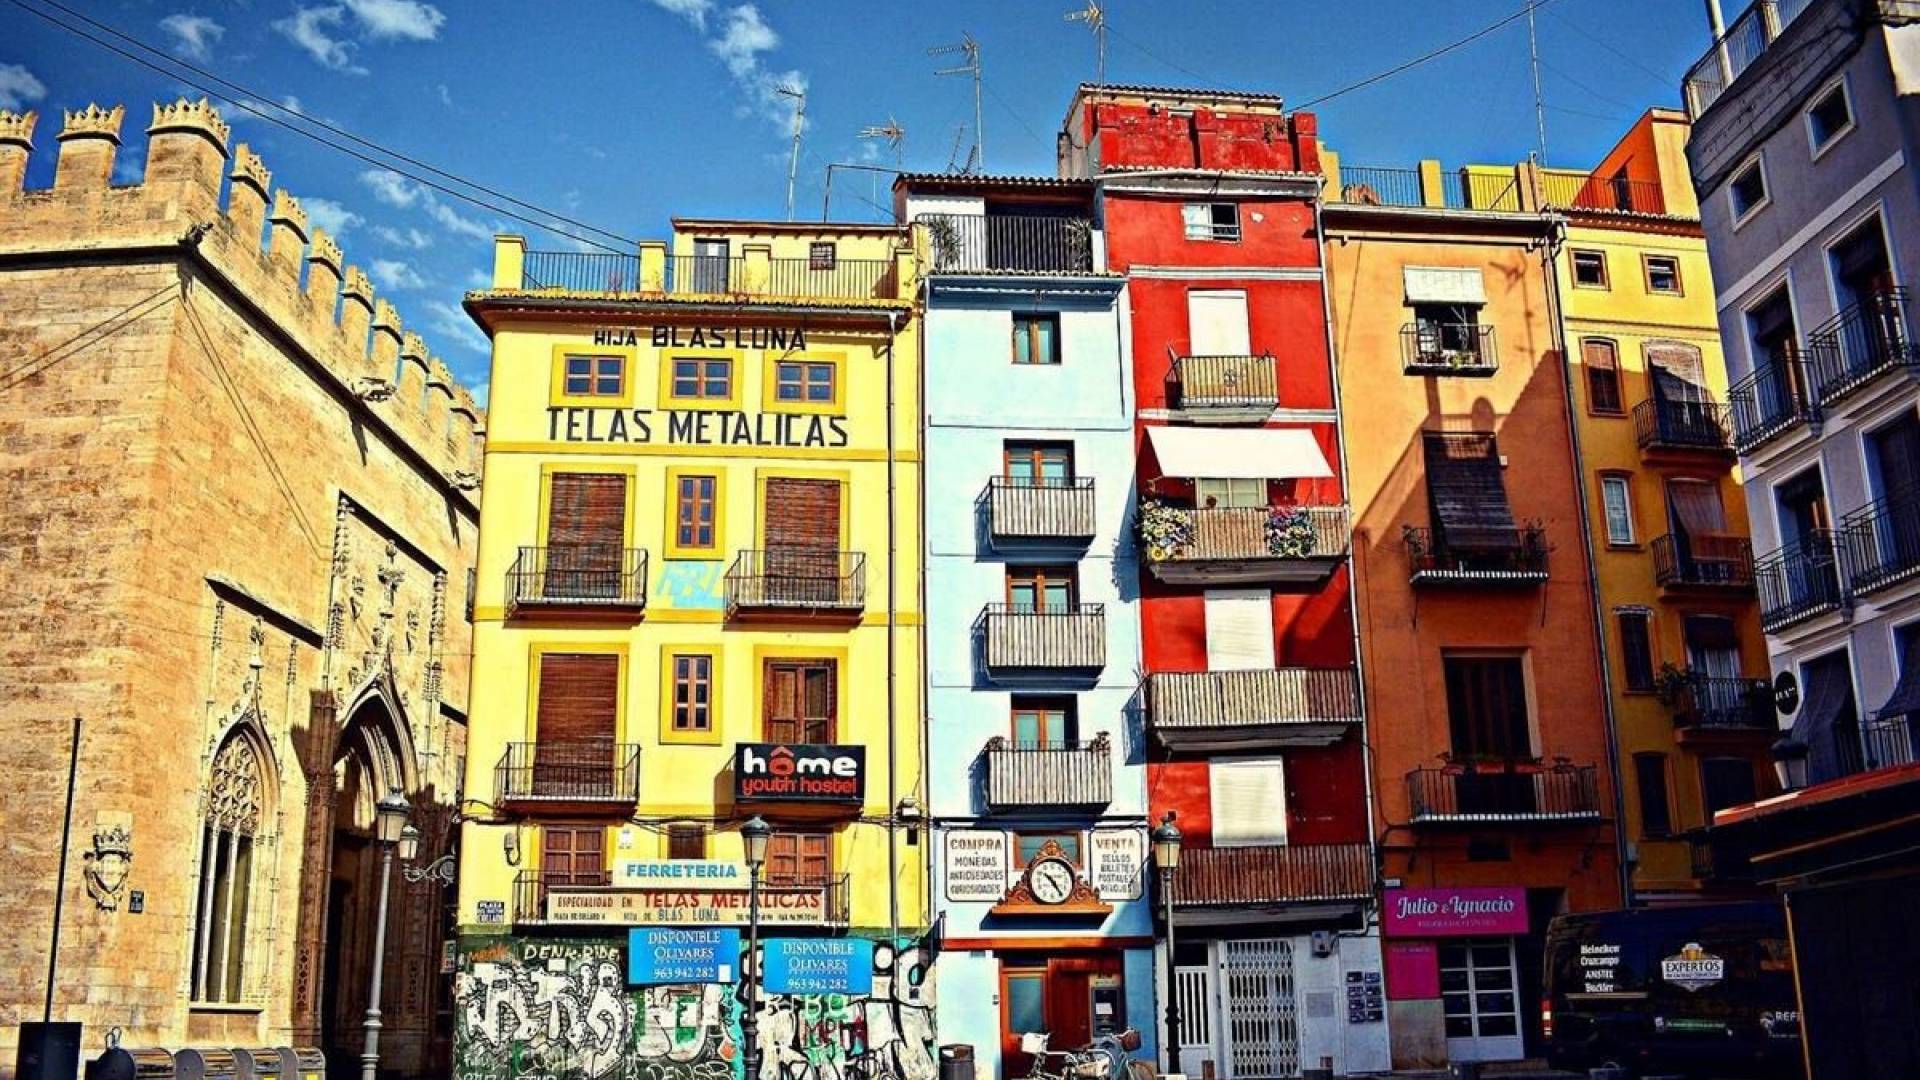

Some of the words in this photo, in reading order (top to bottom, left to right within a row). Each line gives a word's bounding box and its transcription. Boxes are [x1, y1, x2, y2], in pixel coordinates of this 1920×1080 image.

[594, 330, 637, 346] HIJA
[652, 325, 726, 348] BLAS
[735, 327, 806, 350] LUNA
[546, 407, 651, 443] TELAS
[668, 411, 847, 447] METALICAS
[742, 777, 795, 796] youth
[801, 778, 857, 794] hostel
[950, 838, 1002, 850] COMPRA
[1096, 838, 1135, 849] VENTA
[955, 856, 997, 867] MONEDAS
[626, 863, 738, 878] FERRETERIA
[557, 896, 614, 908] ESPECIALIDAD
[643, 892, 700, 909] TELAS
[1396, 896, 1438, 919] Julio
[1449, 895, 1515, 919] Ignacio
[657, 908, 684, 921] BLAS
[648, 930, 721, 944] DISPONIBLE
[654, 946, 714, 959] OLIVARES
[783, 942, 855, 955] DISPONIBLE
[788, 956, 848, 969] OLIVARES
[1666, 962, 1721, 972] EXPERTOS
[654, 968, 673, 979] 963
[674, 967, 694, 978] 942
[696, 967, 715, 978] 282
[788, 979, 806, 990] 963
[830, 979, 849, 989] 282
